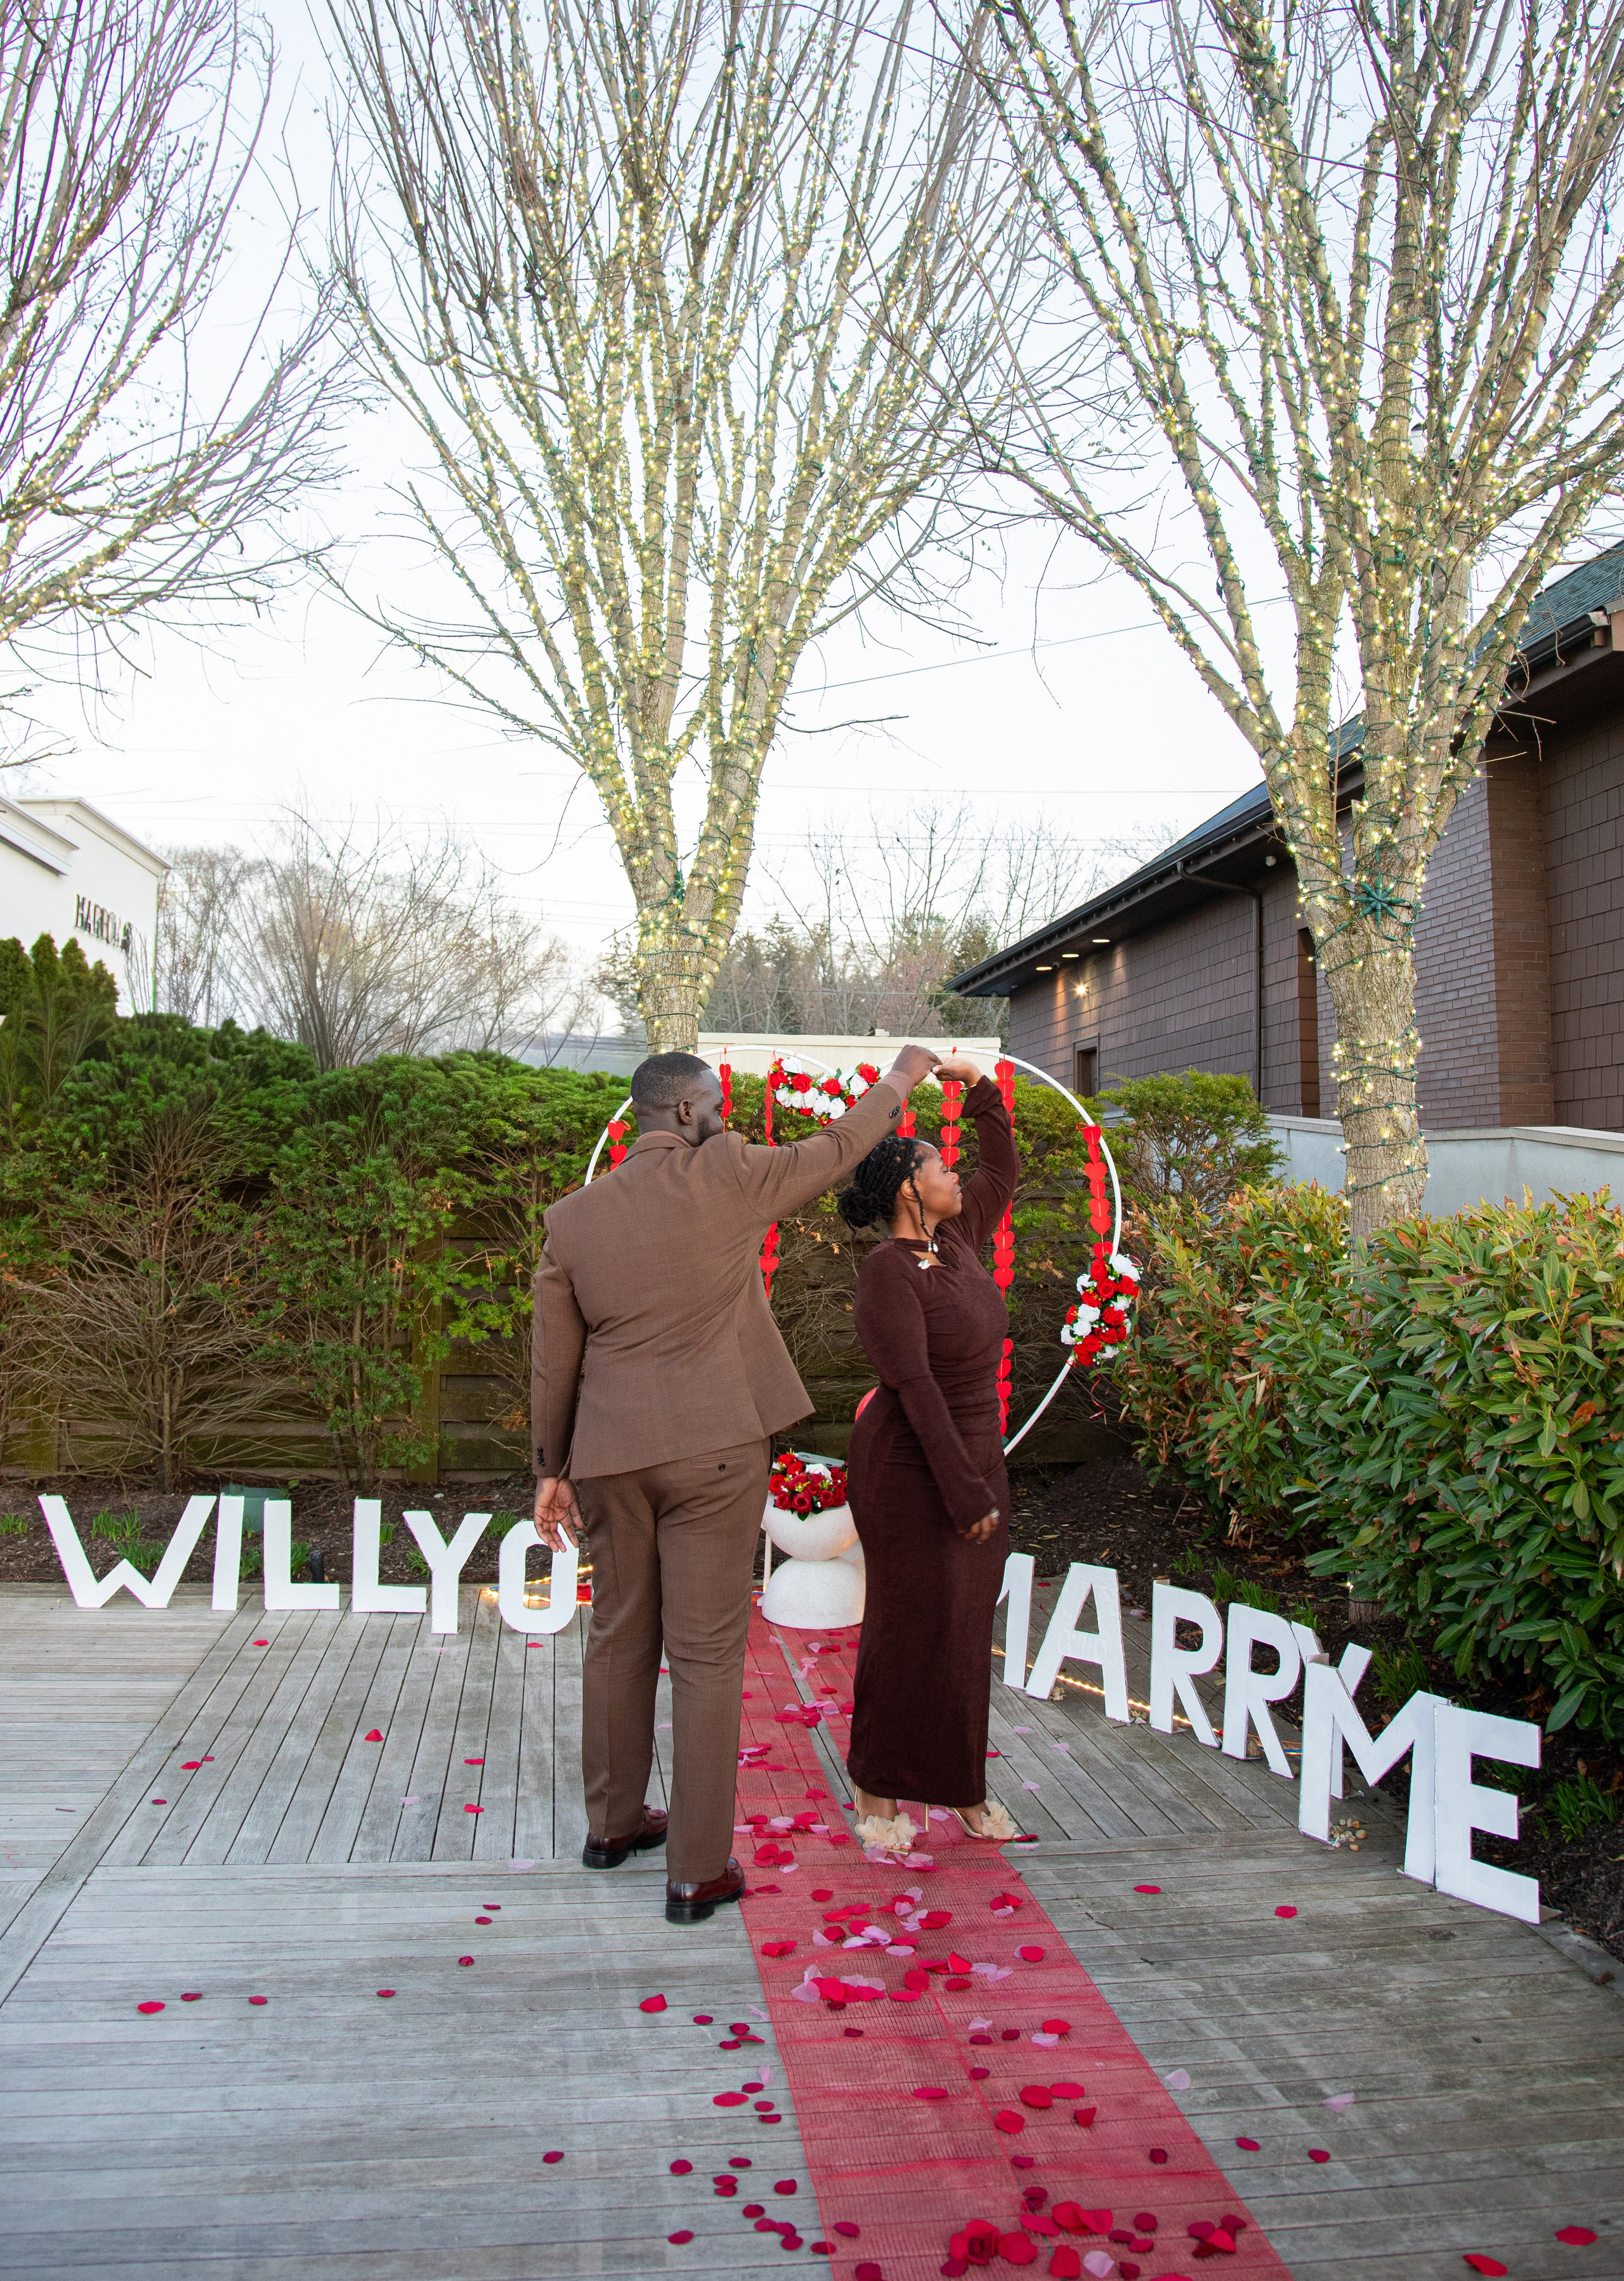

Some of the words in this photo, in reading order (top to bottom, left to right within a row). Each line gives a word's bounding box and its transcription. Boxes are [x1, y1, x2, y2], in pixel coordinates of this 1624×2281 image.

[38, 1493, 427, 1613] WILL
[403, 1510, 580, 1635] YO
[1299, 1654, 1542, 1925] ME
